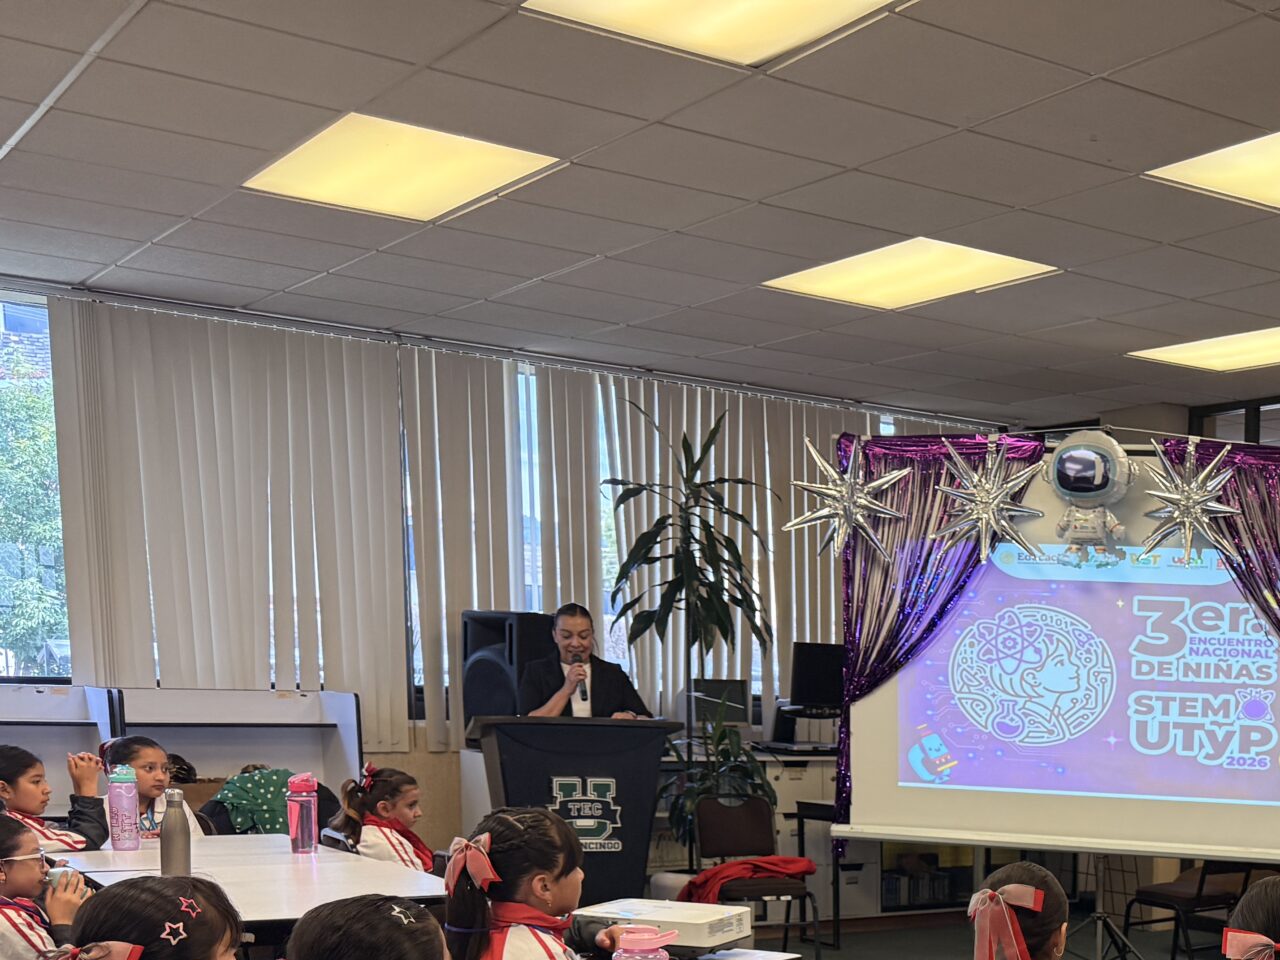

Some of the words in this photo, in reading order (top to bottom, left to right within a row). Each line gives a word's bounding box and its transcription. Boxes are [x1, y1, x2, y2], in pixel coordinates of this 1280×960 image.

[1189, 636, 1274, 648] ENCUENTRO
[1189, 647, 1274, 660] NACIONAL
[1135, 660, 1174, 677] DE
[1182, 659, 1273, 681] NIÑAS
[1134, 695, 1231, 719] STEM
[1135, 720, 1274, 760] UTyP
[1226, 756, 1268, 768] 2026
[568, 802, 603, 816] TEC
